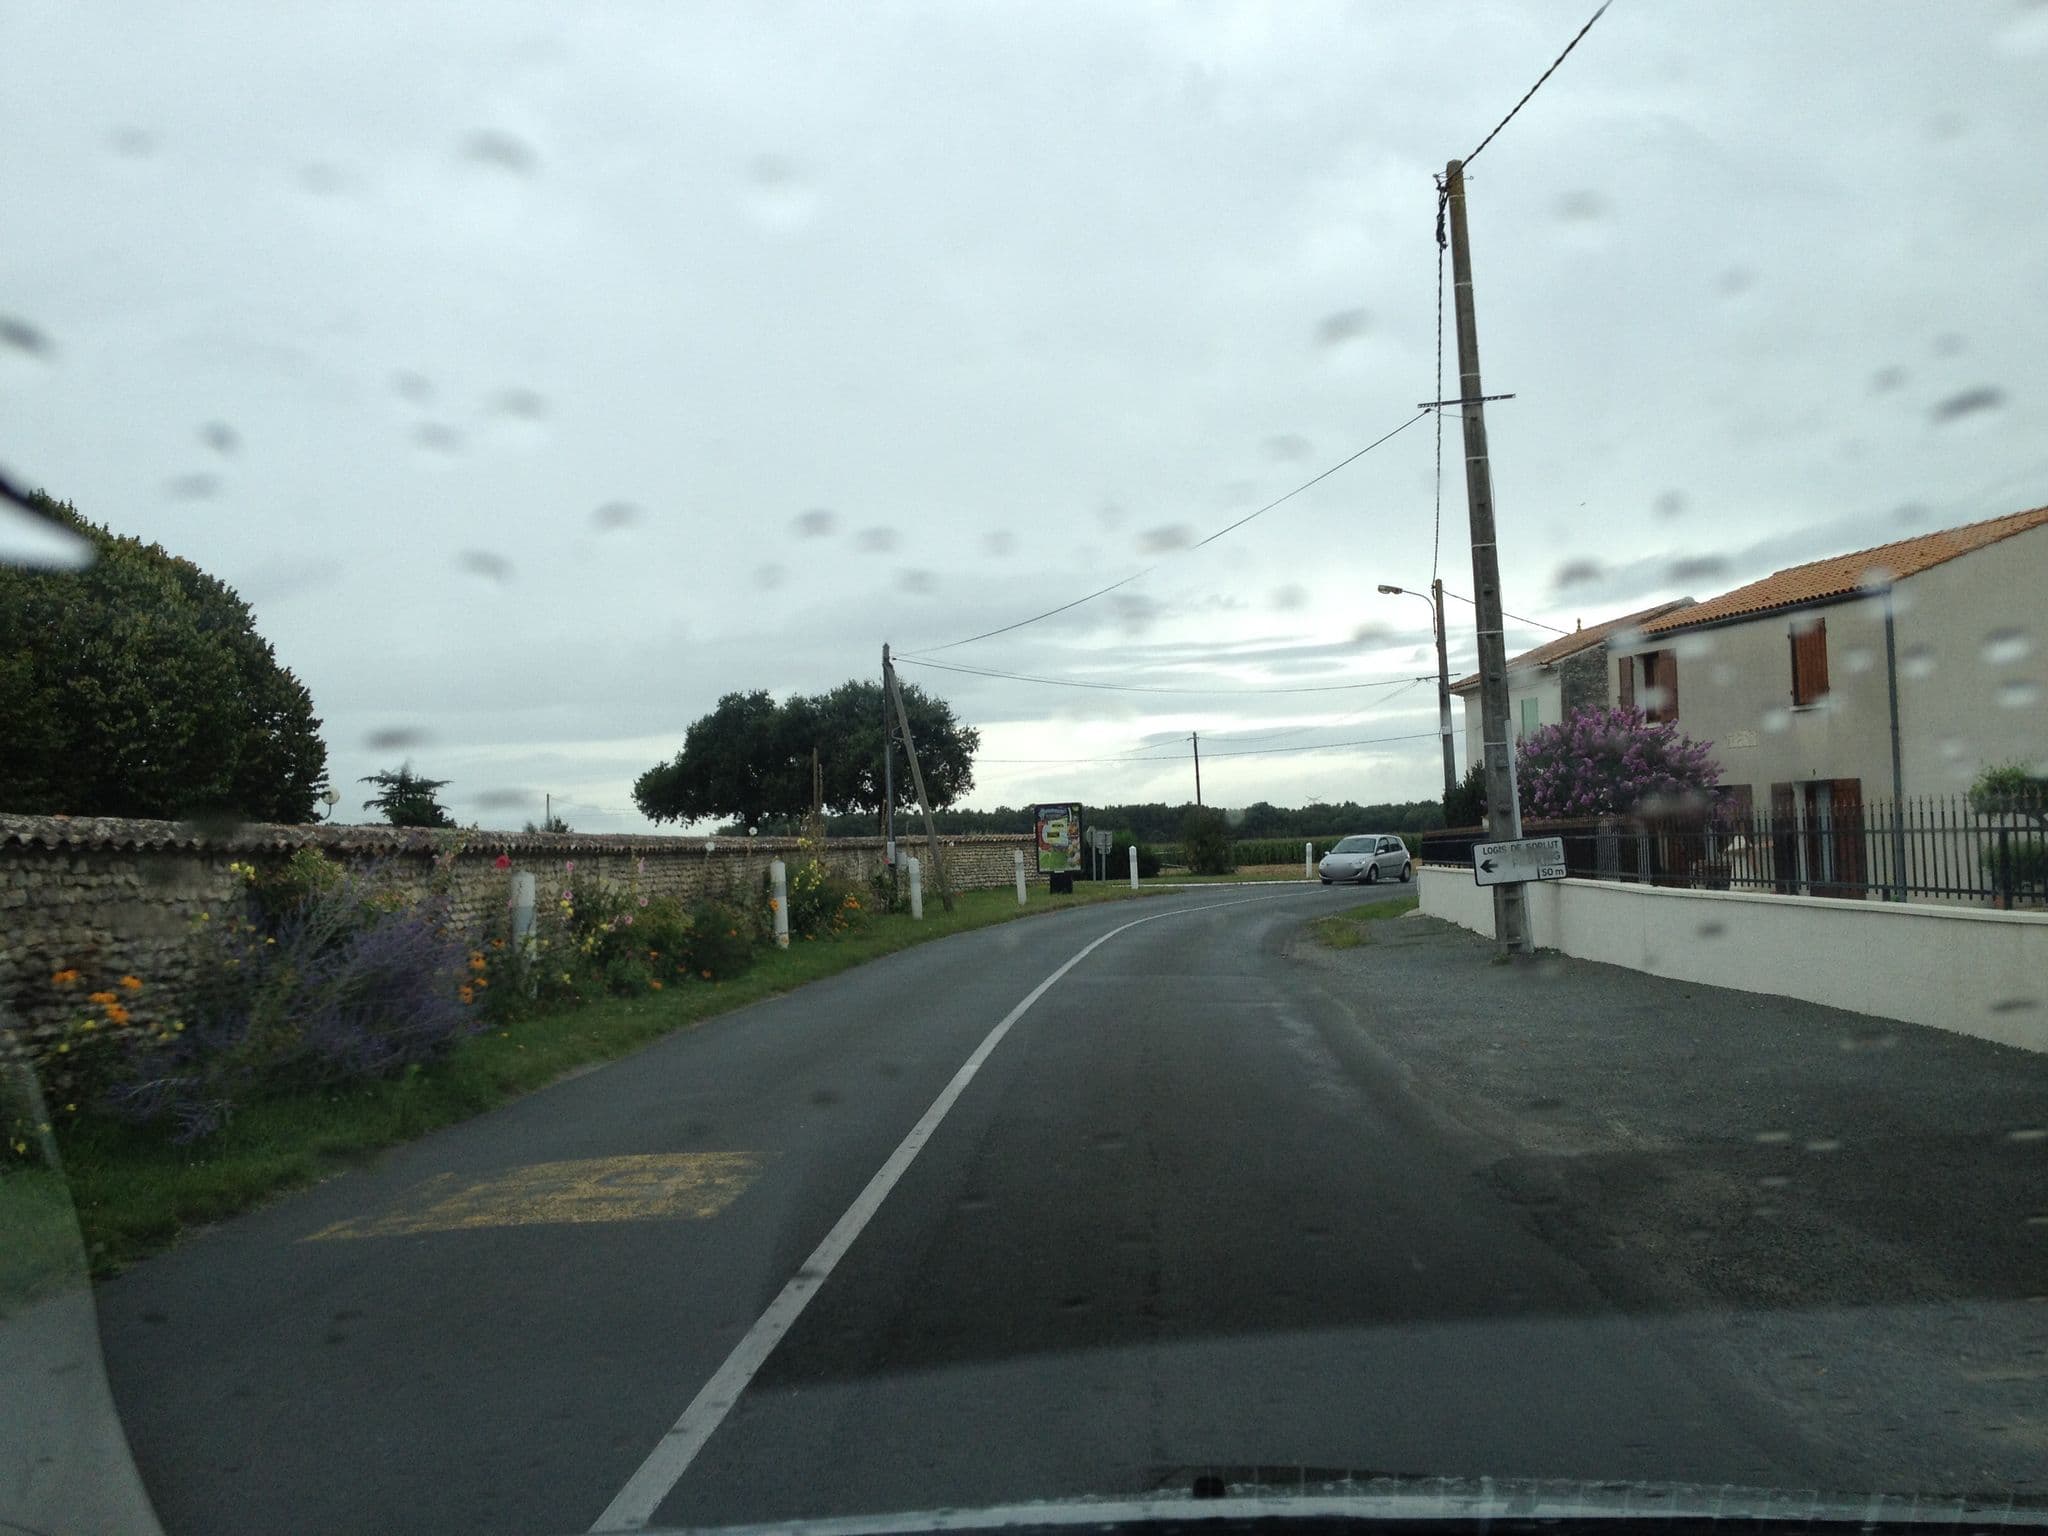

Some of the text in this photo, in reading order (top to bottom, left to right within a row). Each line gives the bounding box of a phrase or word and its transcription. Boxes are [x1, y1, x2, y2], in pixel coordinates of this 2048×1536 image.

[1482, 845, 1507, 855] LOGIS
[1542, 868, 1564, 876] 50 m
